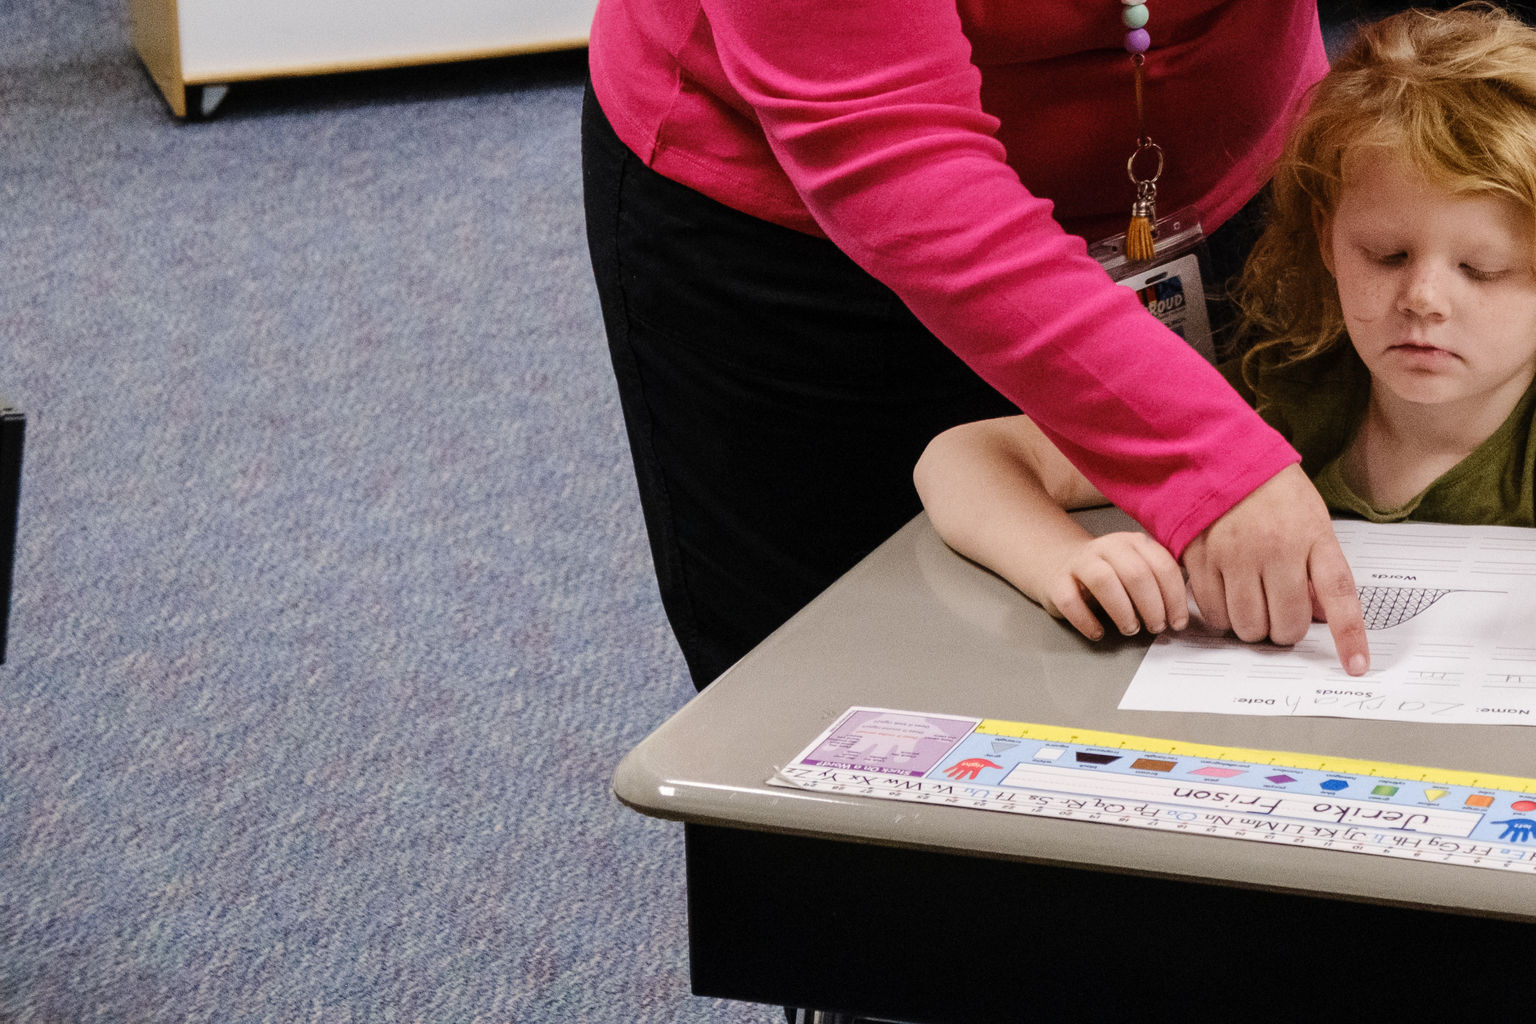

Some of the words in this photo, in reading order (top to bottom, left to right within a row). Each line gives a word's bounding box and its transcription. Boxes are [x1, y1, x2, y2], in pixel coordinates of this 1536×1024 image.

[1147, 294, 1183, 315] ROUD
[1315, 689, 1373, 697] Sounds
[1233, 697, 1276, 705] Date:
[816, 761, 851, 770] Word?
[785, 768, 812, 778] Zz
[818, 769, 837, 781] Yy
[847, 775, 877, 785] Xx
[884, 779, 922, 791] Ww
[933, 784, 954, 794] Vv
[964, 788, 990, 798] Uu
[995, 792, 1015, 802] Tt
[1029, 795, 1054, 805] Ss
[1173, 788, 1282, 815] Frison
[1061, 799, 1087, 809] Rr
[1094, 799, 1125, 813] Qq
[1134, 804, 1160, 817] Pp
[1167, 810, 1198, 822] Oo
[1205, 814, 1234, 825] Nn
[1313, 803, 1429, 832] Jeriko
[1241, 818, 1279, 830] Mm
[1282, 824, 1304, 833] Ll
[1311, 827, 1338, 837] Kk
[1343, 828, 1366, 841] Jj
[1374, 834, 1384, 844] Ii
[1393, 836, 1422, 848] Hh
[1428, 838, 1460, 852] Gg
[1463, 846, 1492, 856] Ff
[1501, 849, 1526, 860] Ee
